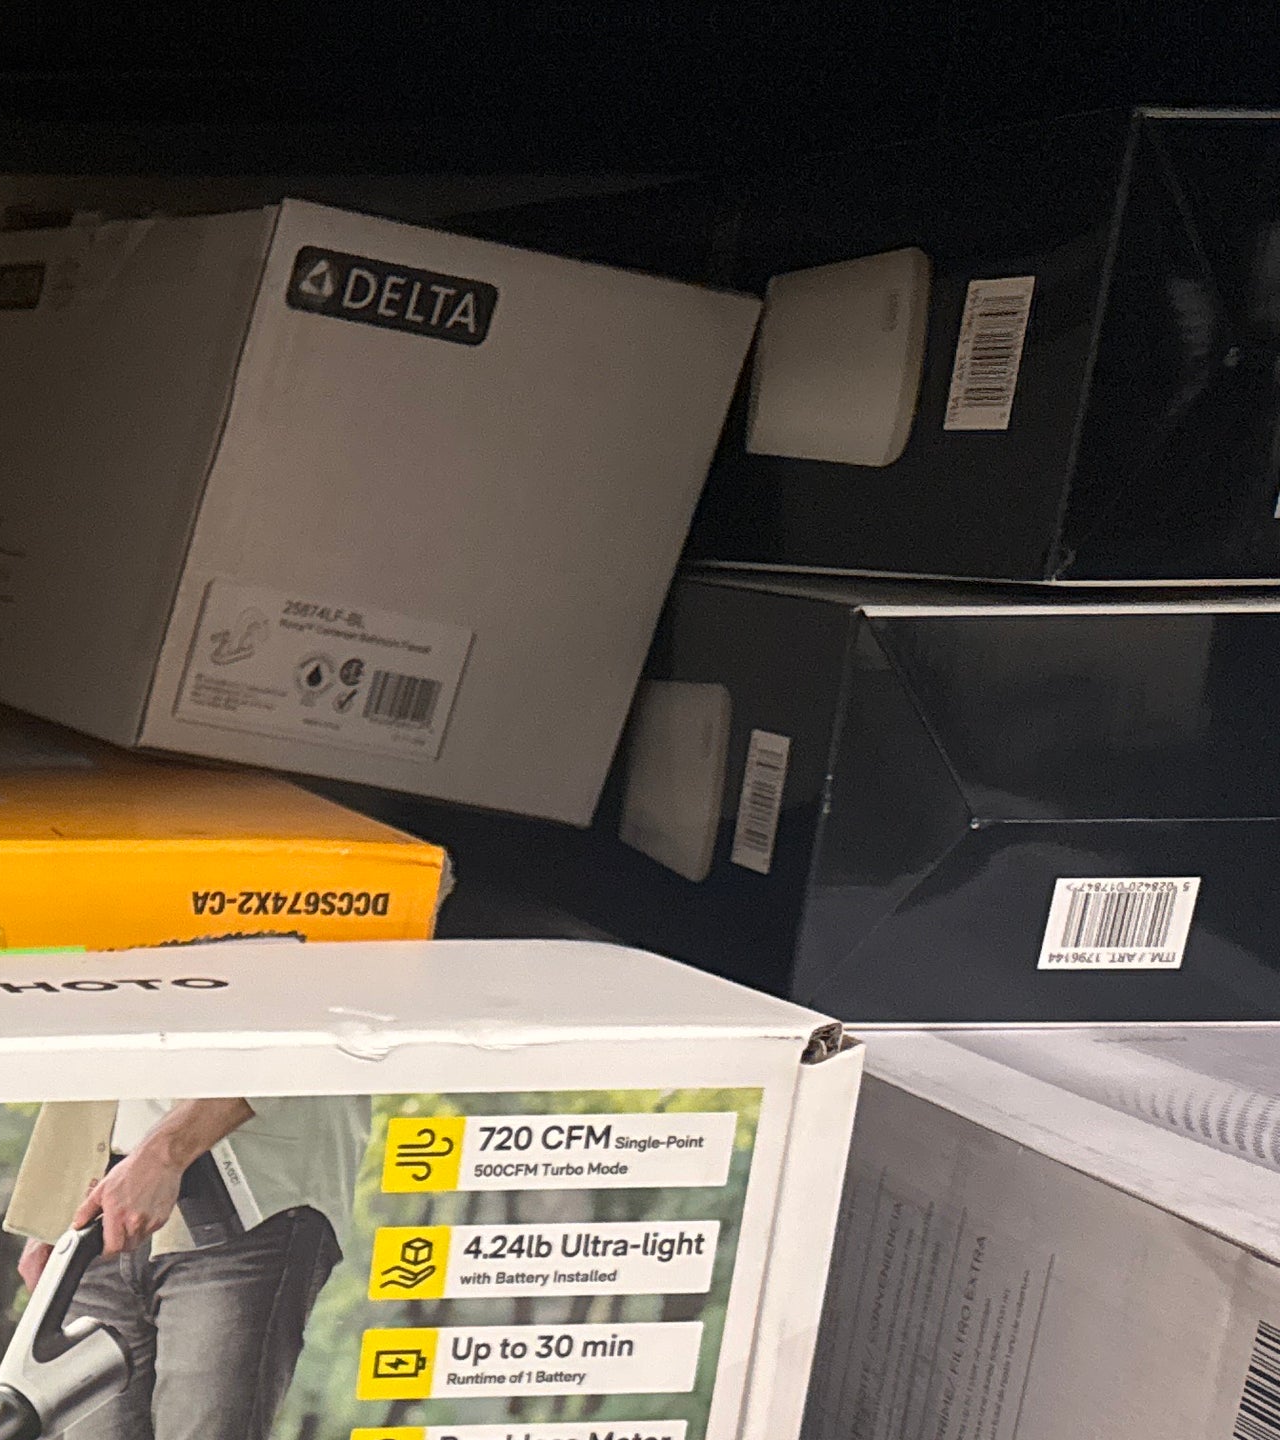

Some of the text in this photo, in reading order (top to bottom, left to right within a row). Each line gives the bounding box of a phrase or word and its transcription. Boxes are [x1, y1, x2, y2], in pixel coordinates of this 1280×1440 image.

[342, 267, 479, 336] DELTA
[191, 889, 391, 918] DCCS674X2-CA
[478, 1125, 705, 1152] 720 CFM Single-Point
[473, 1161, 629, 1178] 500CFM Turbo Mode
[463, 1231, 707, 1262] 4.24lb Ultra-light
[459, 1268, 618, 1288] with Battery Installed
[451, 1334, 635, 1367] Up to 30 min
[446, 1371, 507, 1386] Runtime
[509, 1370, 525, 1386] of
[534, 1370, 587, 1387] Battery
